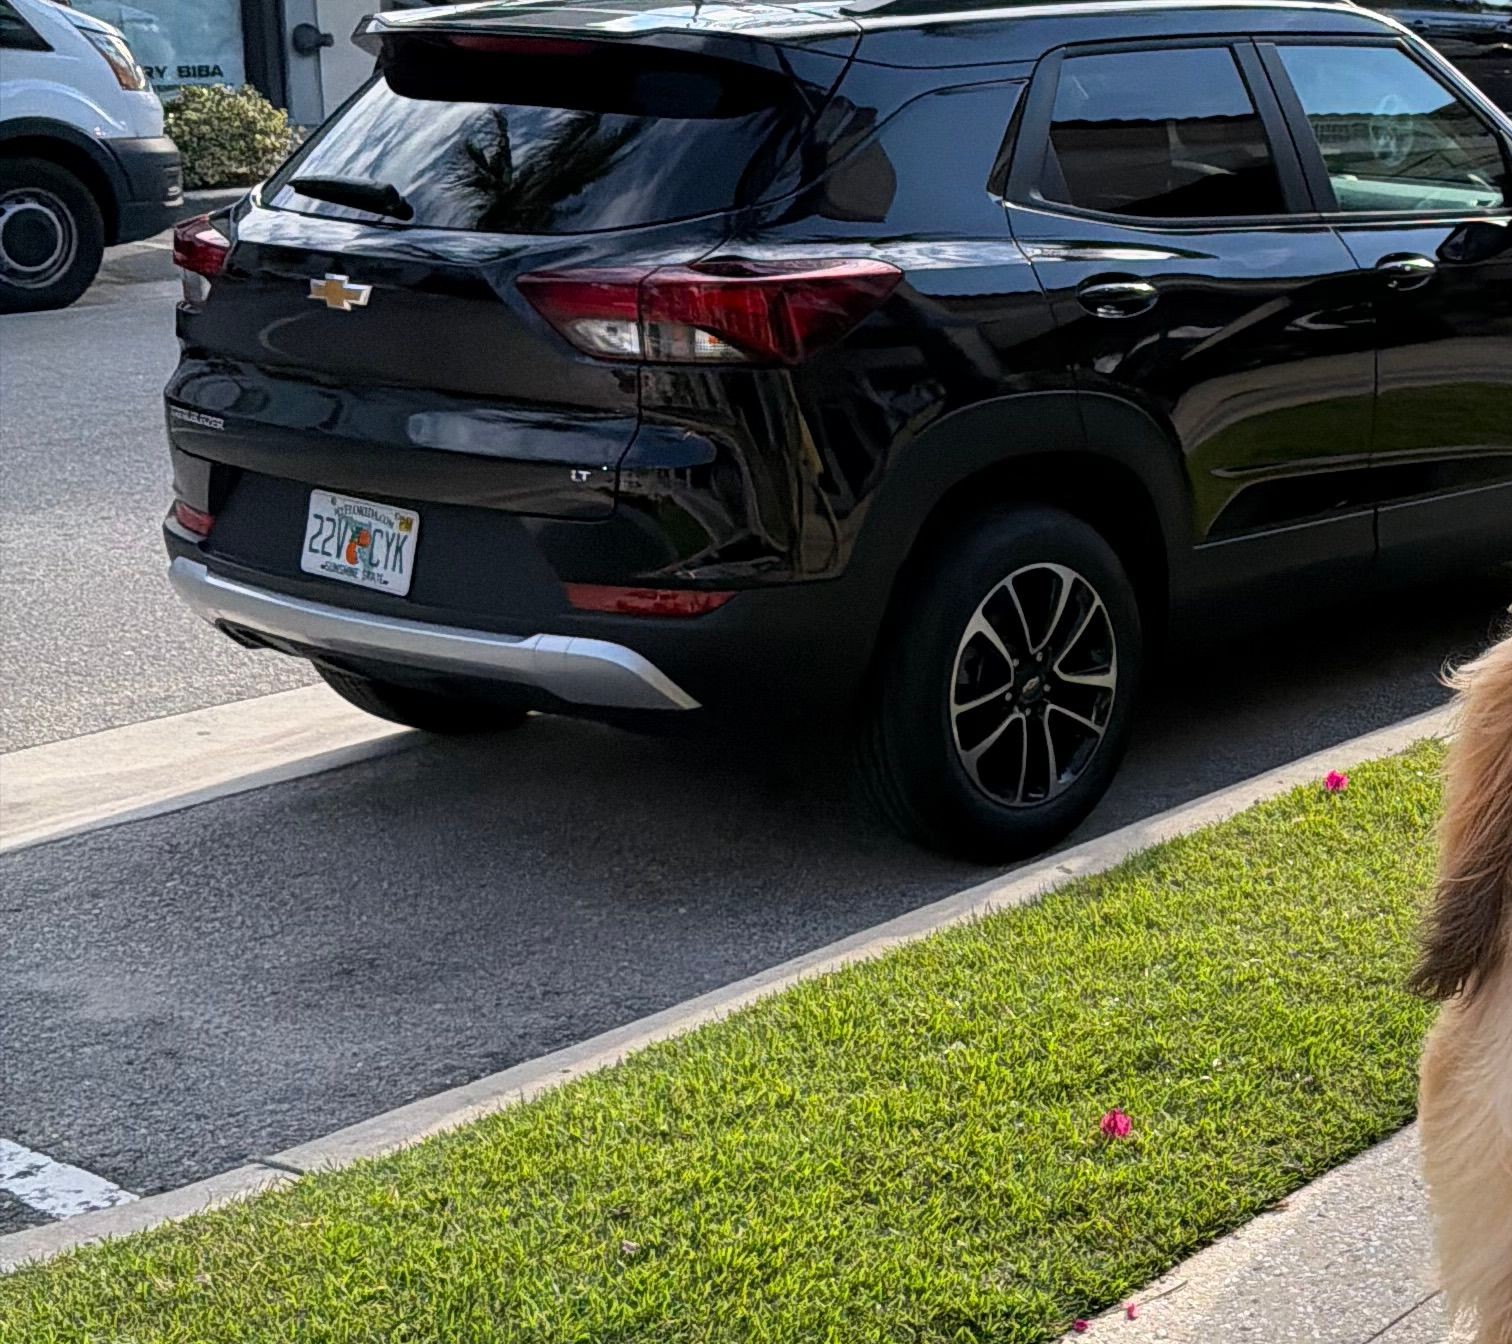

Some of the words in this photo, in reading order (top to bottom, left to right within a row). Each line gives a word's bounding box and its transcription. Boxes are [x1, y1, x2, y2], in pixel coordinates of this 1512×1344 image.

[176, 64, 224, 79] BIBA
[570, 469, 592, 482] LT
[308, 513, 349, 560] 22V
[369, 527, 408, 575] CYK
